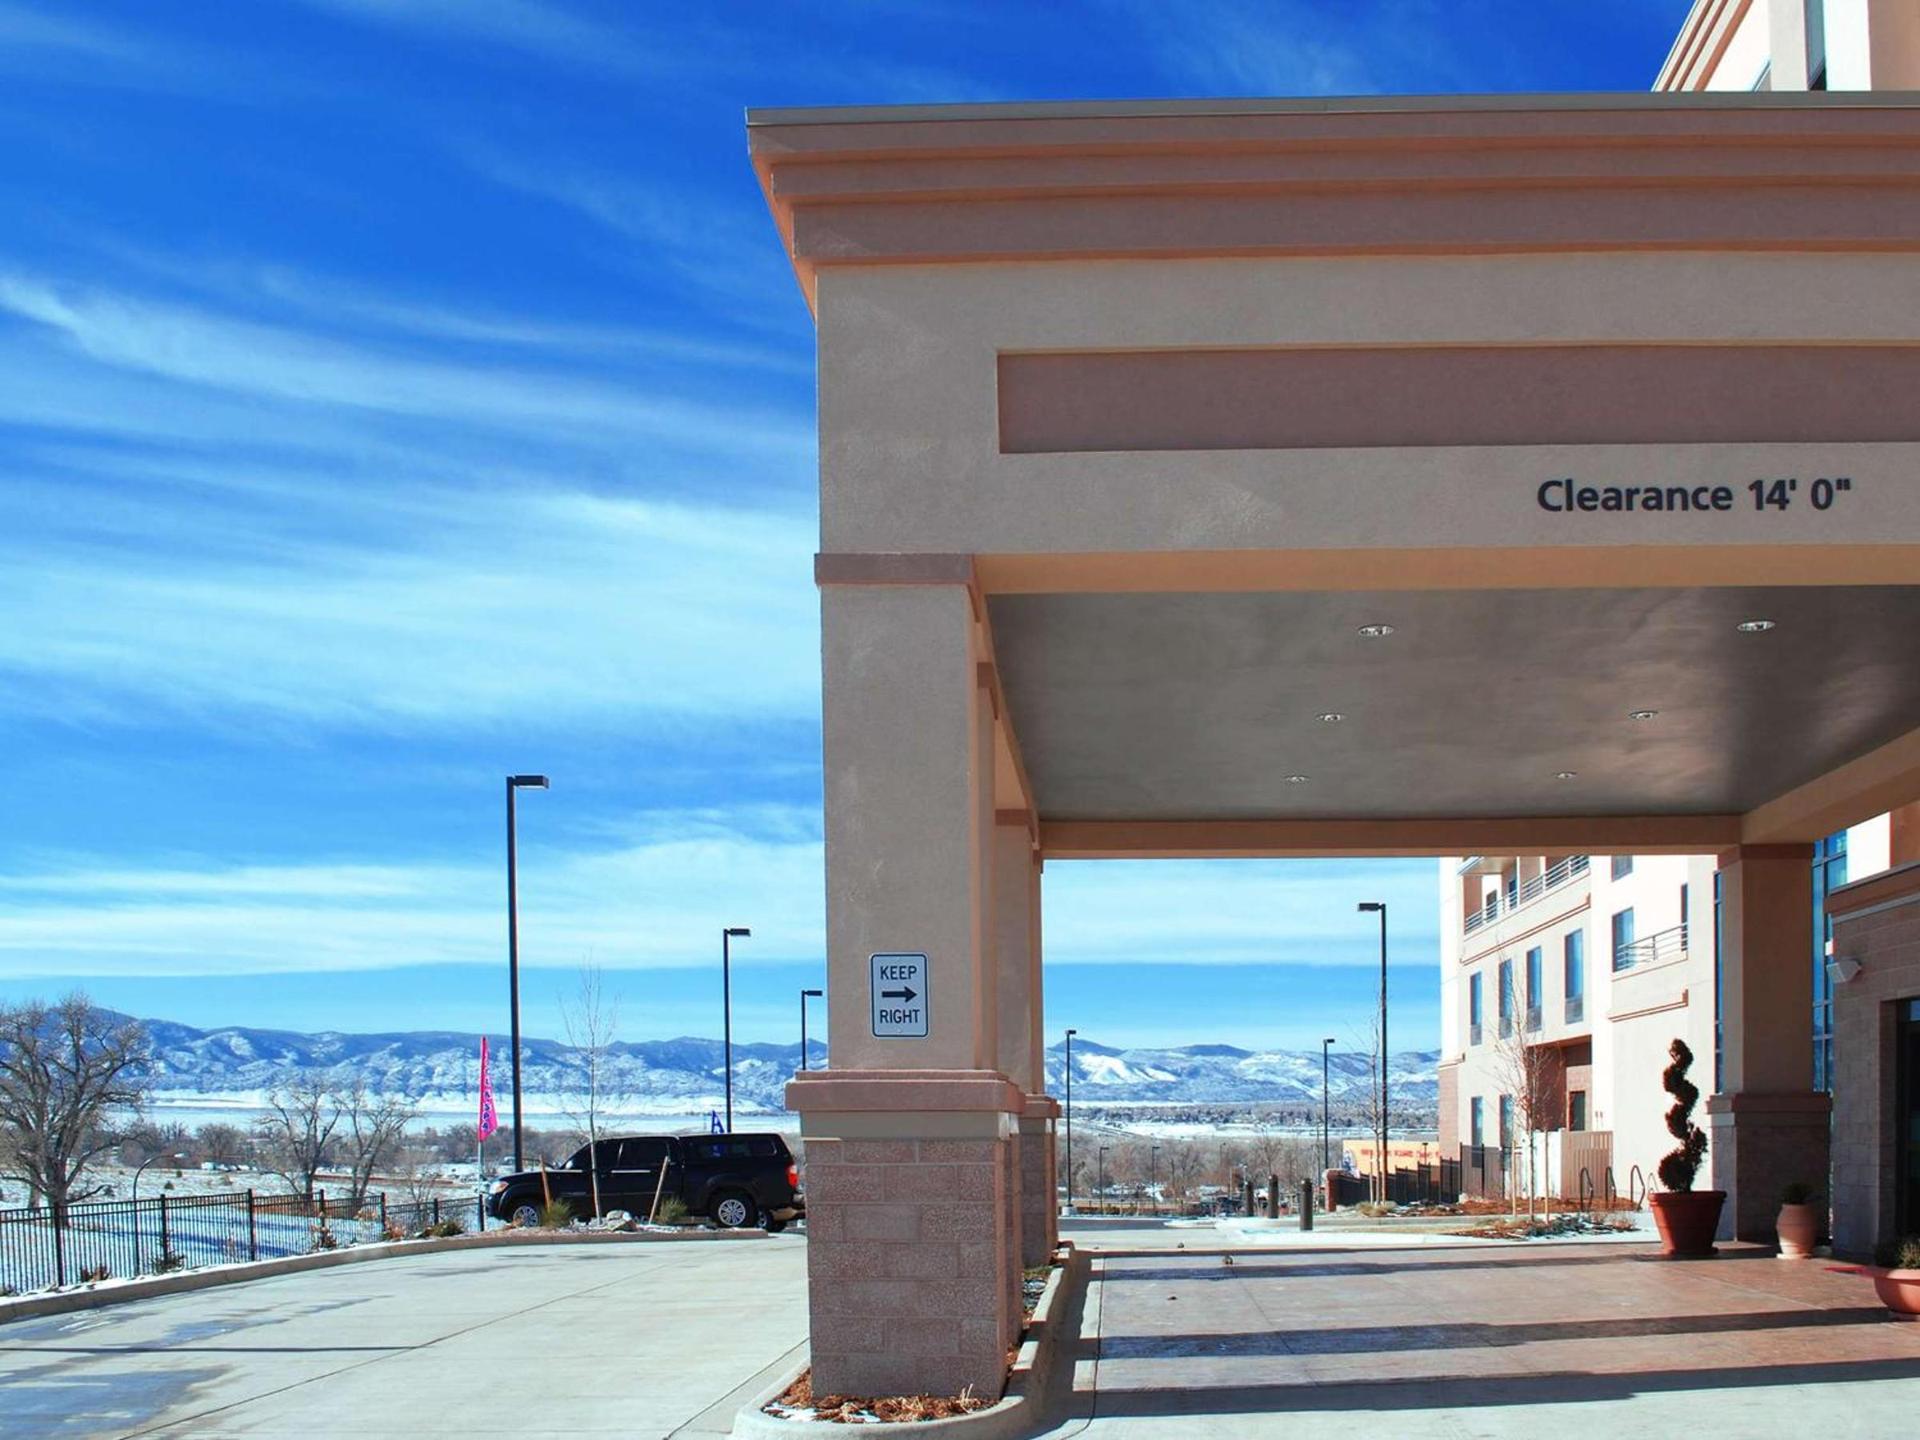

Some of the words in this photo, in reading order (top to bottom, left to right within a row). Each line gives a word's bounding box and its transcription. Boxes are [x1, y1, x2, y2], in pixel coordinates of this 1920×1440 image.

[1537, 478, 1734, 512] Clearance
[1748, 478, 1796, 511] 14'
[1810, 478, 1852, 511] 0"
[880, 965, 917, 980] KEEP
[880, 1009, 920, 1024] RIGHT
